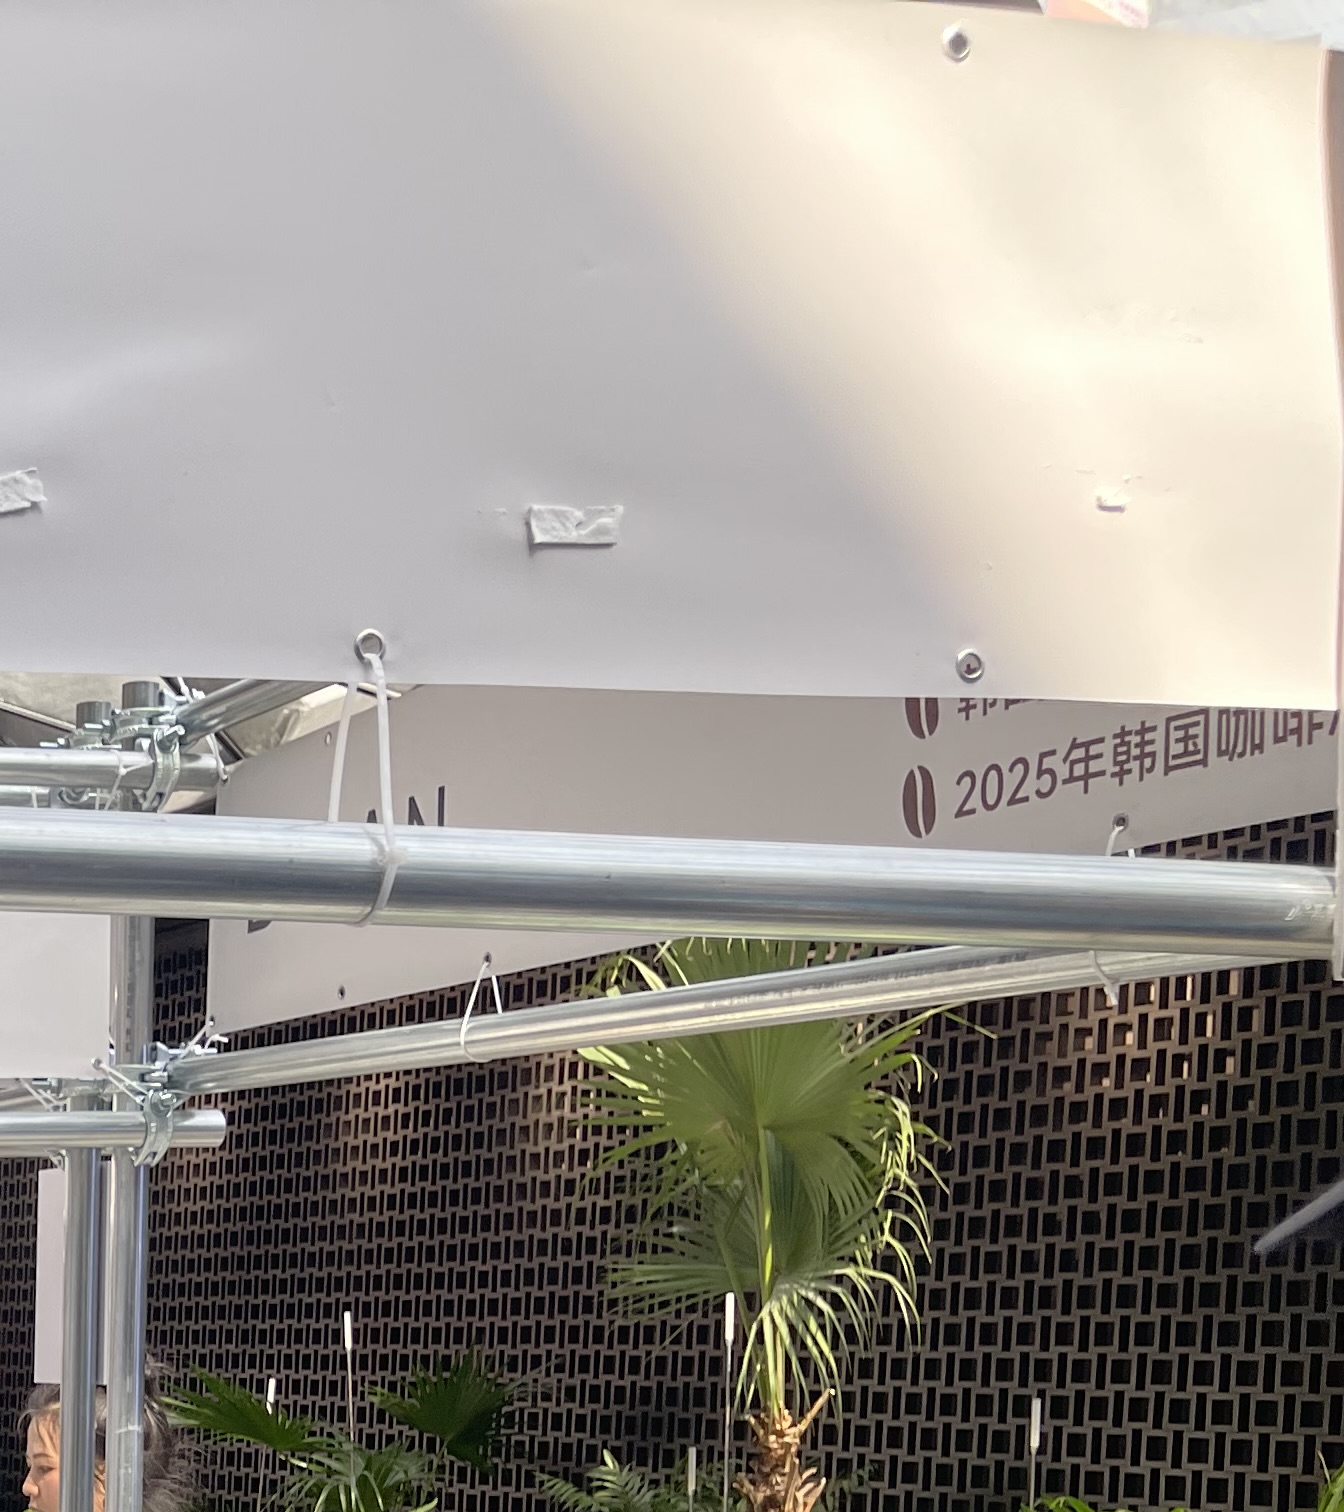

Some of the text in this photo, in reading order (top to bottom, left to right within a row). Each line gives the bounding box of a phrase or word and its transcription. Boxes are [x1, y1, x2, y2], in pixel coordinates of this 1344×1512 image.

[953, 708, 1337, 819] 2025年韩国咖啡
